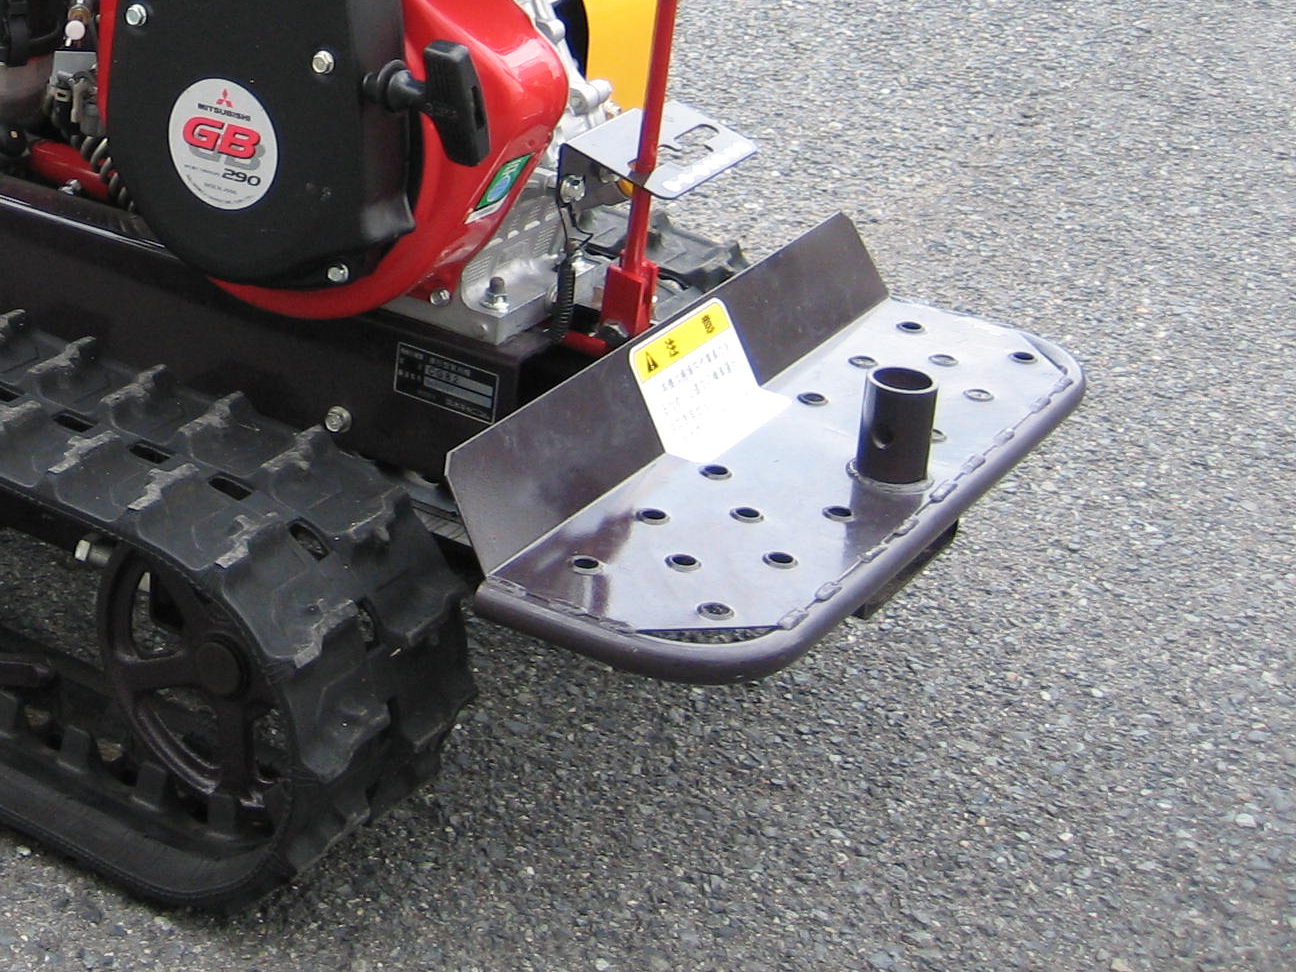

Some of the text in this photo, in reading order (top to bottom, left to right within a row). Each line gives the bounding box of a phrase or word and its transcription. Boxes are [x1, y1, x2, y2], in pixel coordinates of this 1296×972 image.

[197, 103, 251, 122] MITSUBISHI
[182, 116, 261, 160] GB
[222, 168, 261, 187] 290
